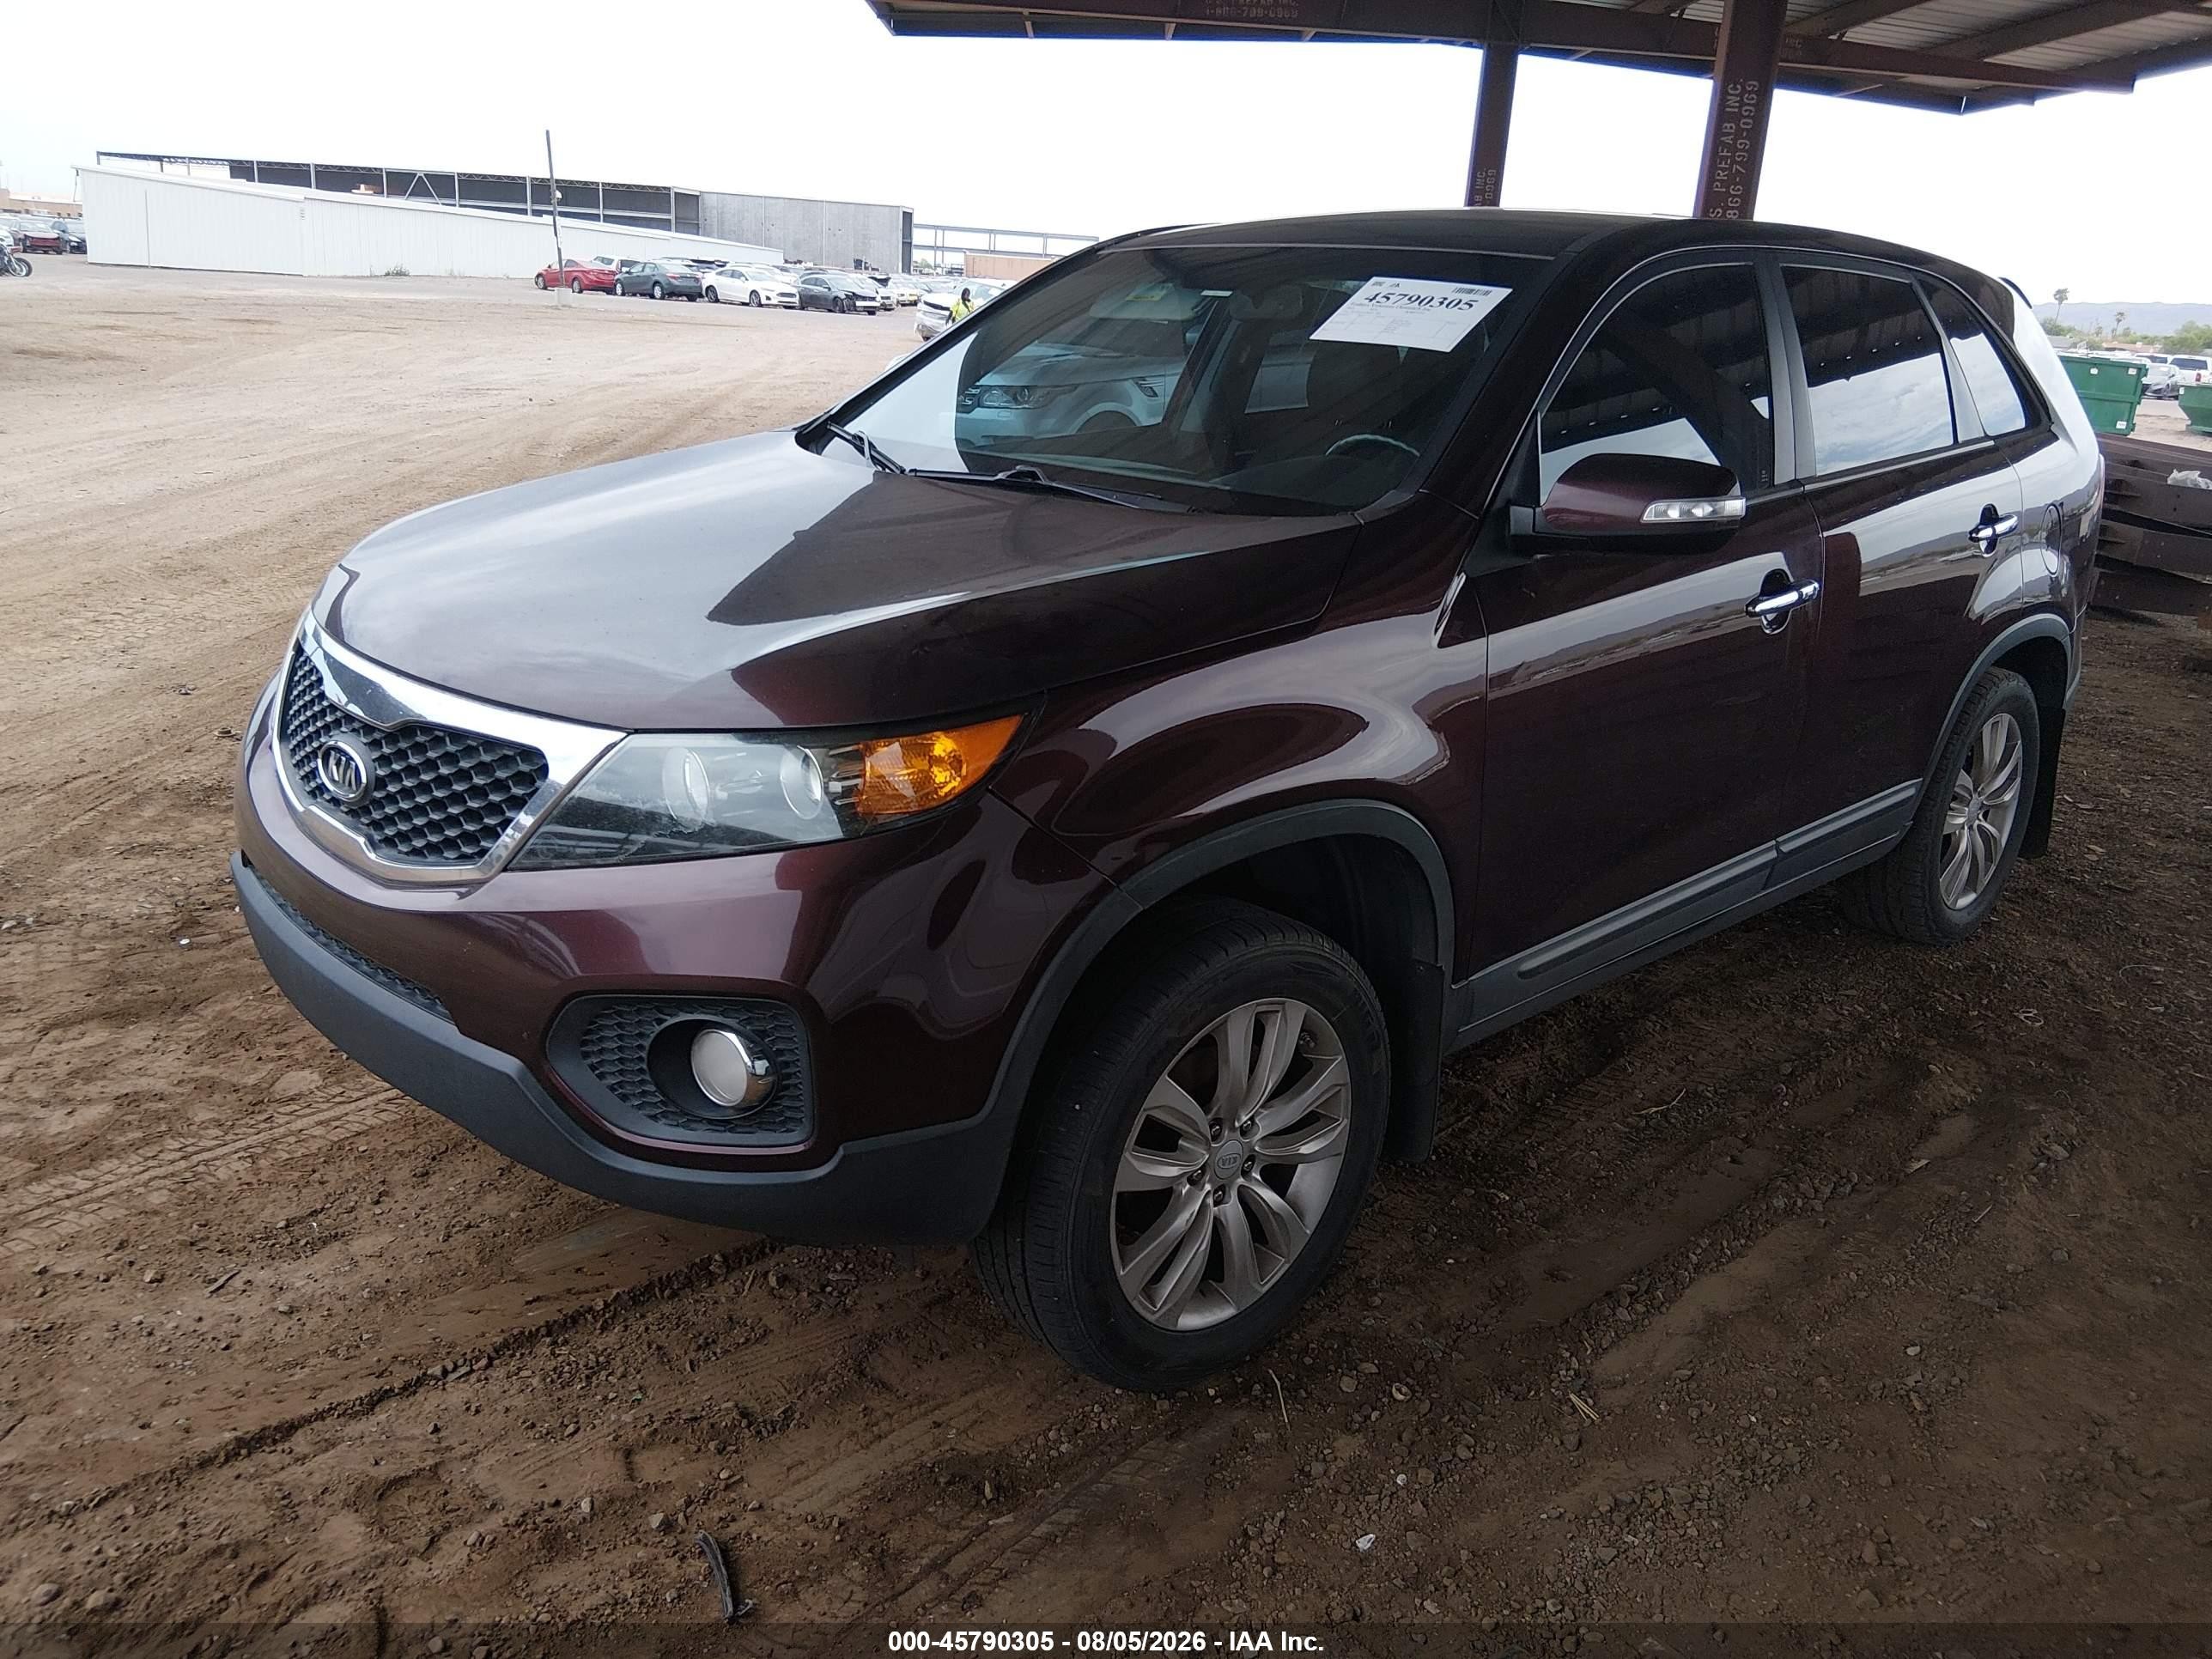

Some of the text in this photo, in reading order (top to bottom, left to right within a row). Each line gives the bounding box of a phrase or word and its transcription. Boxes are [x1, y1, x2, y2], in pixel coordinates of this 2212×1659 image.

[1712, 123, 1735, 192] PREFAB
[1725, 78, 1744, 112] INC.
[1364, 291, 1479, 312] 45790305
